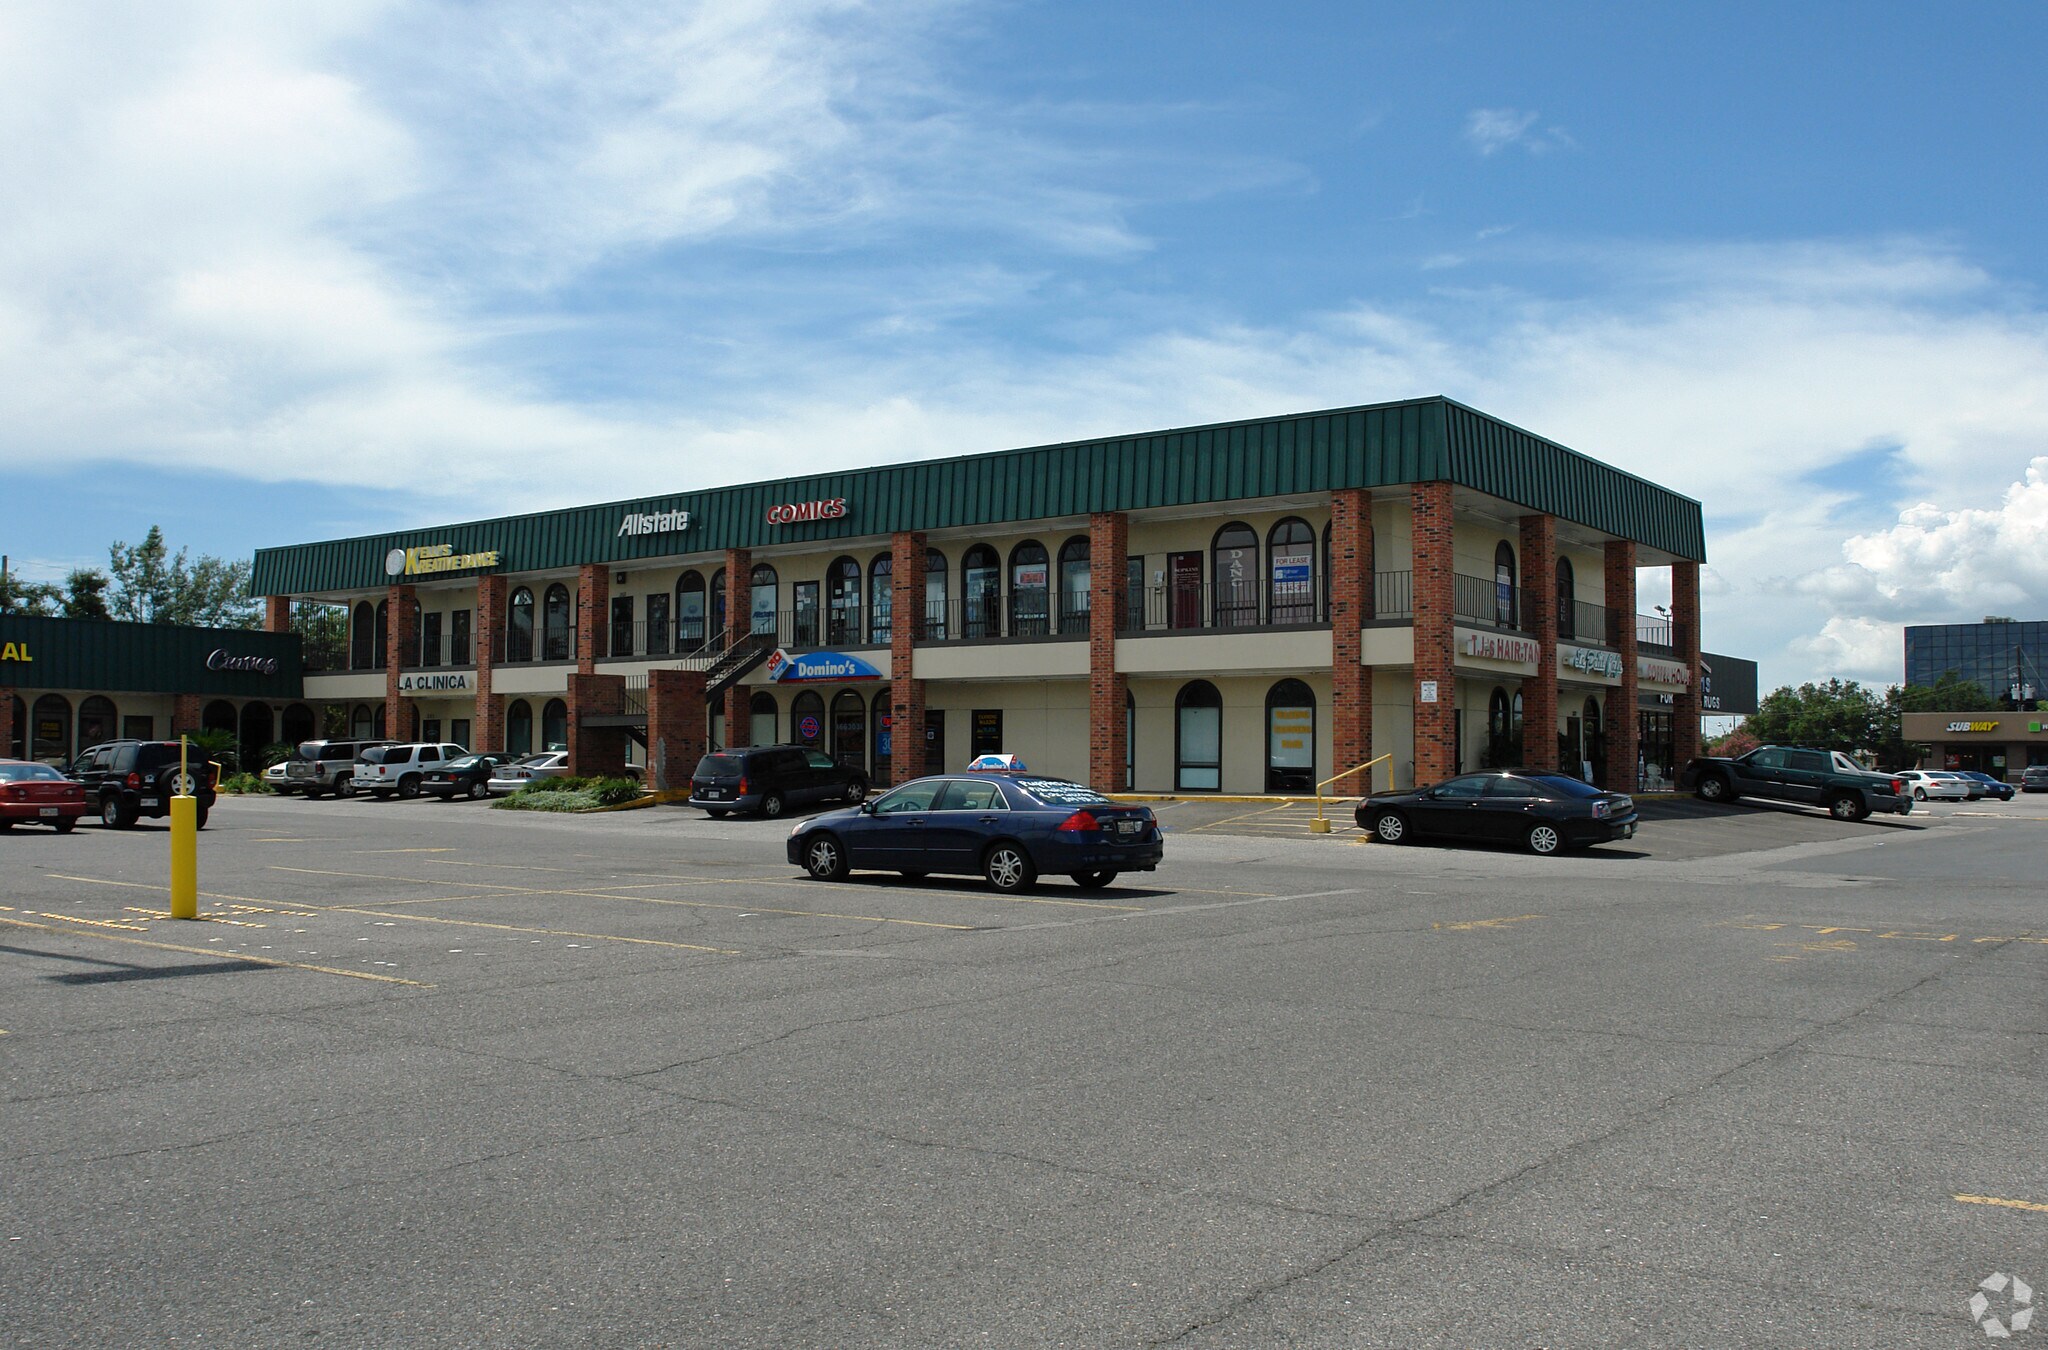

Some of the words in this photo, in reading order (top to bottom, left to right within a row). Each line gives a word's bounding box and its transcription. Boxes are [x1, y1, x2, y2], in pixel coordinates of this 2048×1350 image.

[767, 498, 847, 524] COMICS
[617, 509, 691, 537] Allstate
[460, 551, 500, 569] DANCE
[1289, 556, 1309, 564] LEASE
[1, 642, 33, 662] AL
[206, 648, 278, 675] Curves
[798, 660, 856, 677] Domino's
[397, 676, 412, 690] LA
[416, 675, 466, 690] CLINICA
[1703, 695, 1720, 709] RUGS
[1946, 721, 1999, 732] SUBWAY
